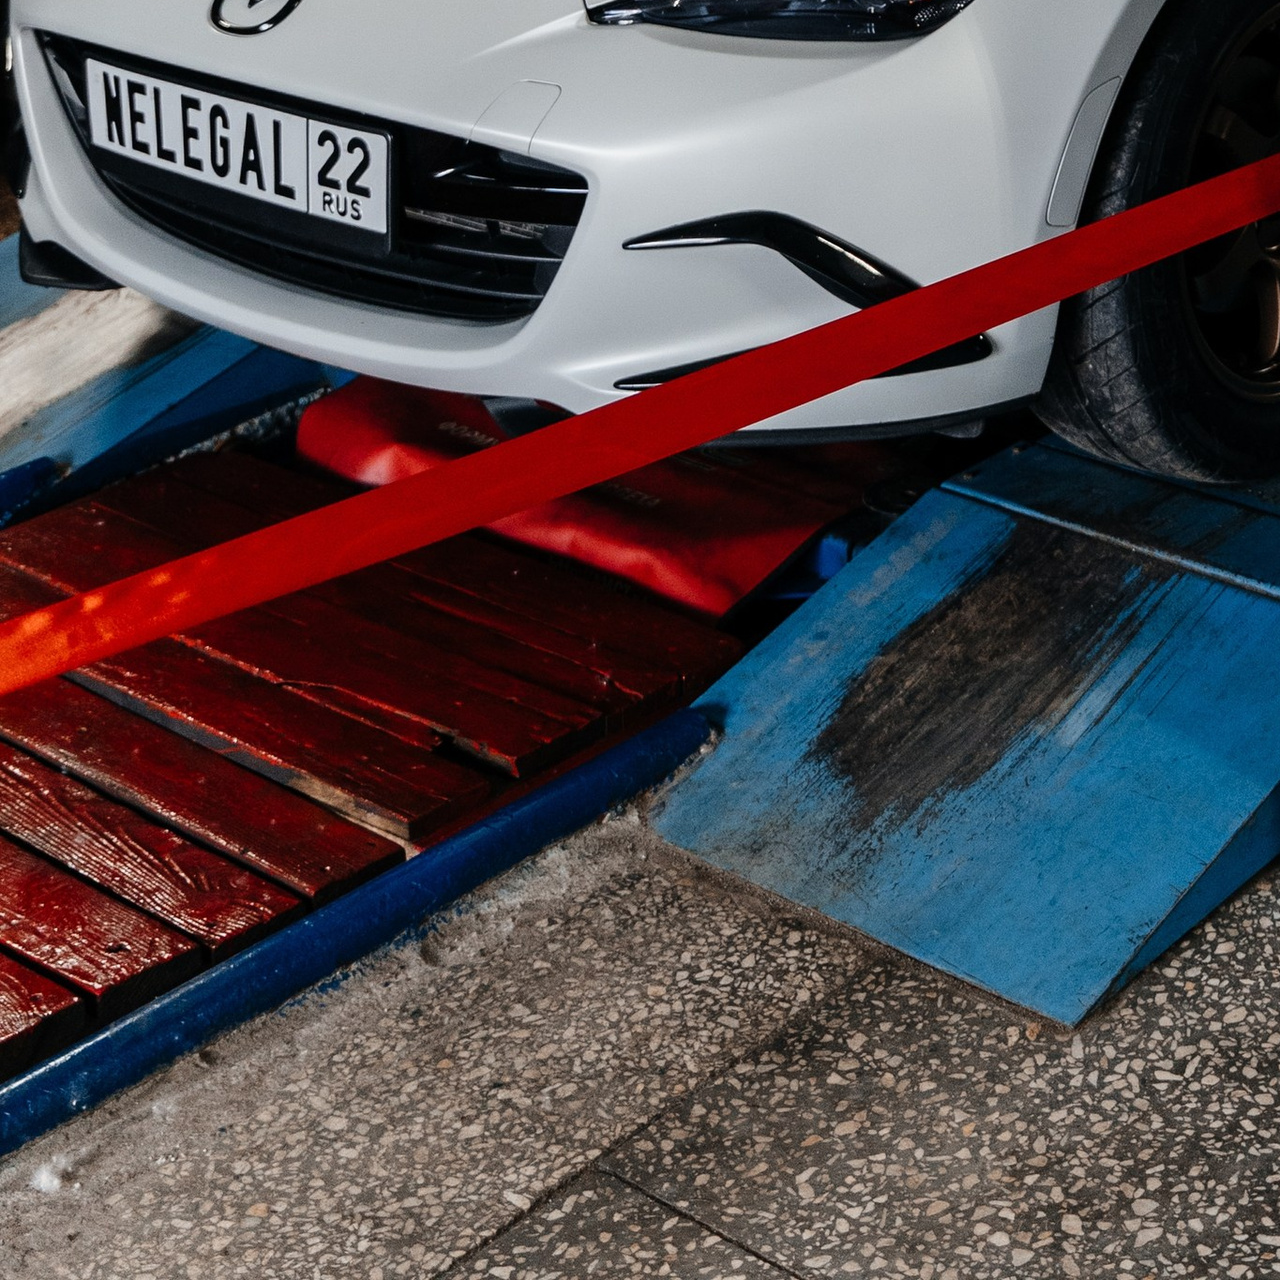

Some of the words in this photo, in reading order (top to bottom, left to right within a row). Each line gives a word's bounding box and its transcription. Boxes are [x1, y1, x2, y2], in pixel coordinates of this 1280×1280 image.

[103, 70, 296, 201] NELEGAL
[317, 129, 371, 199] 22
[322, 191, 362, 221] RUS
